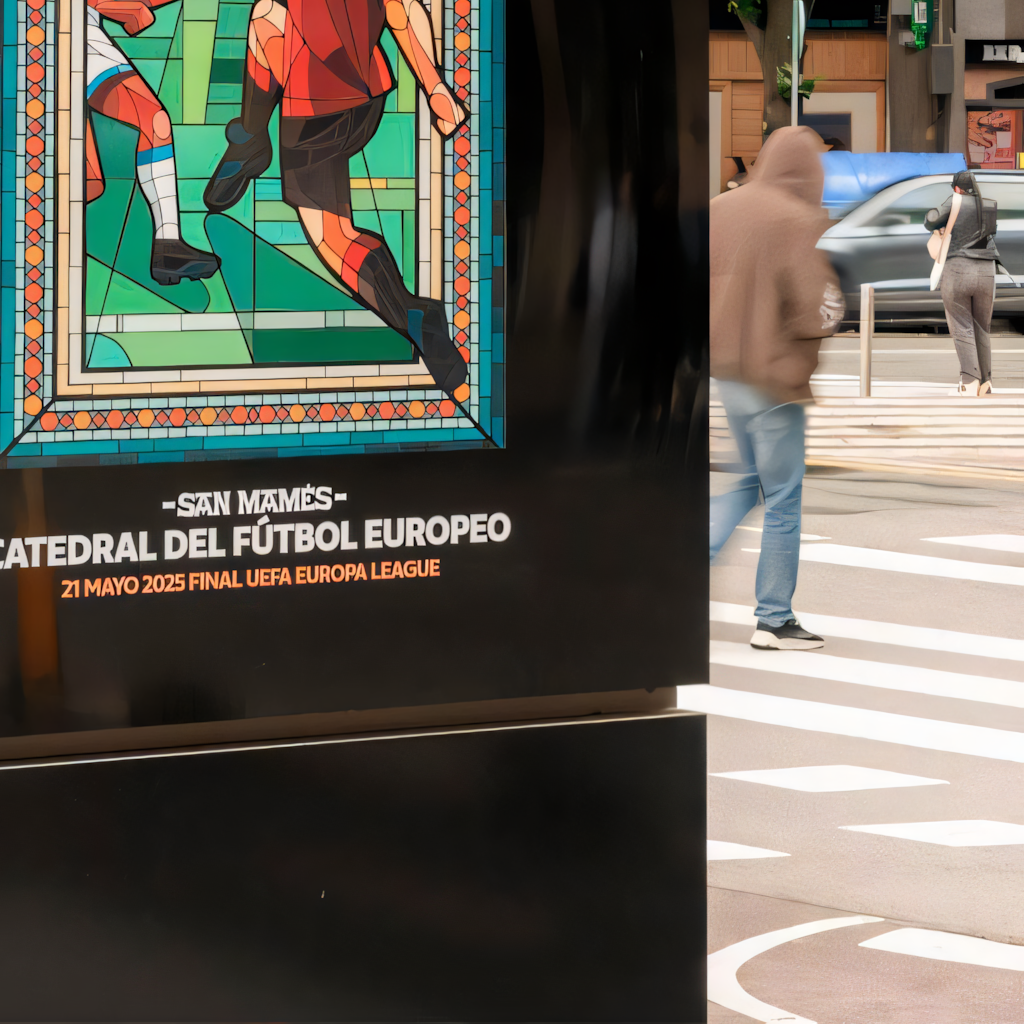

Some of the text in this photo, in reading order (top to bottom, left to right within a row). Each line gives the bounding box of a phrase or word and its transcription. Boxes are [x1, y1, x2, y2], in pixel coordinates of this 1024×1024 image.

[164, 527, 226, 560] DEL
[232, 514, 359, 557] FÚTBOL
[364, 512, 512, 549] EUROPEO
[61, 558, 441, 599] 21 MAYO 2025 FINAL UEFA EUROPA LEAGUE
